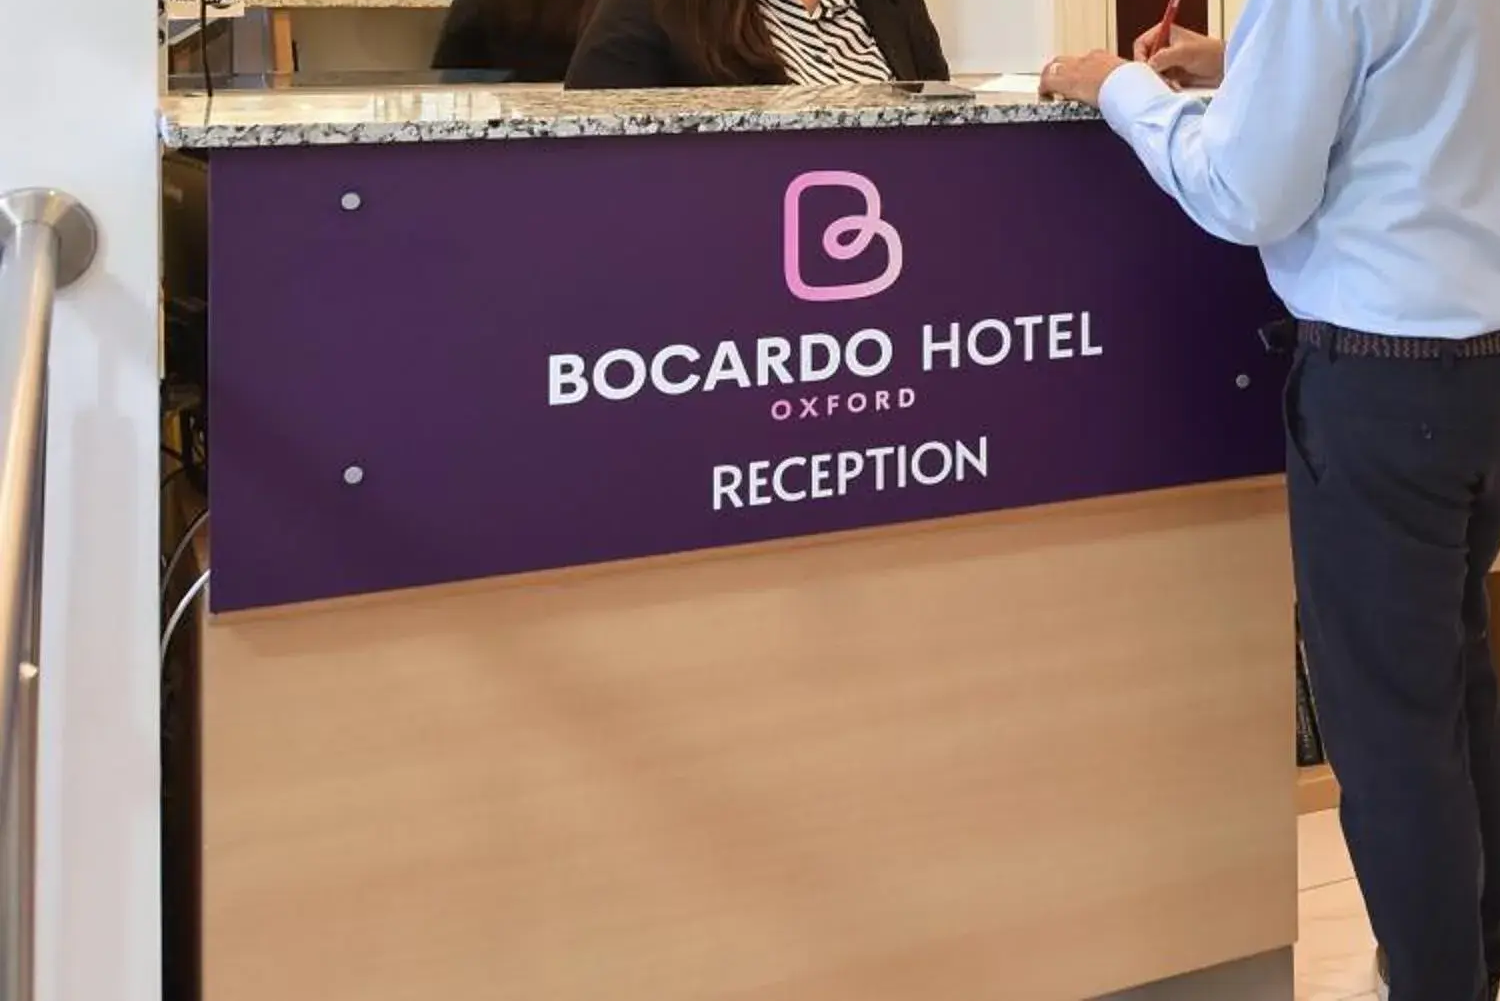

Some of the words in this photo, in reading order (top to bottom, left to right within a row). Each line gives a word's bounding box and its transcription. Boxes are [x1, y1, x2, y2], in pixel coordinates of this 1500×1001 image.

[548, 328, 893, 406] BOCARDO
[922, 310, 1104, 372] HOTEL
[770, 387, 917, 421] OXFORD
[712, 436, 989, 511] RECEPTION
